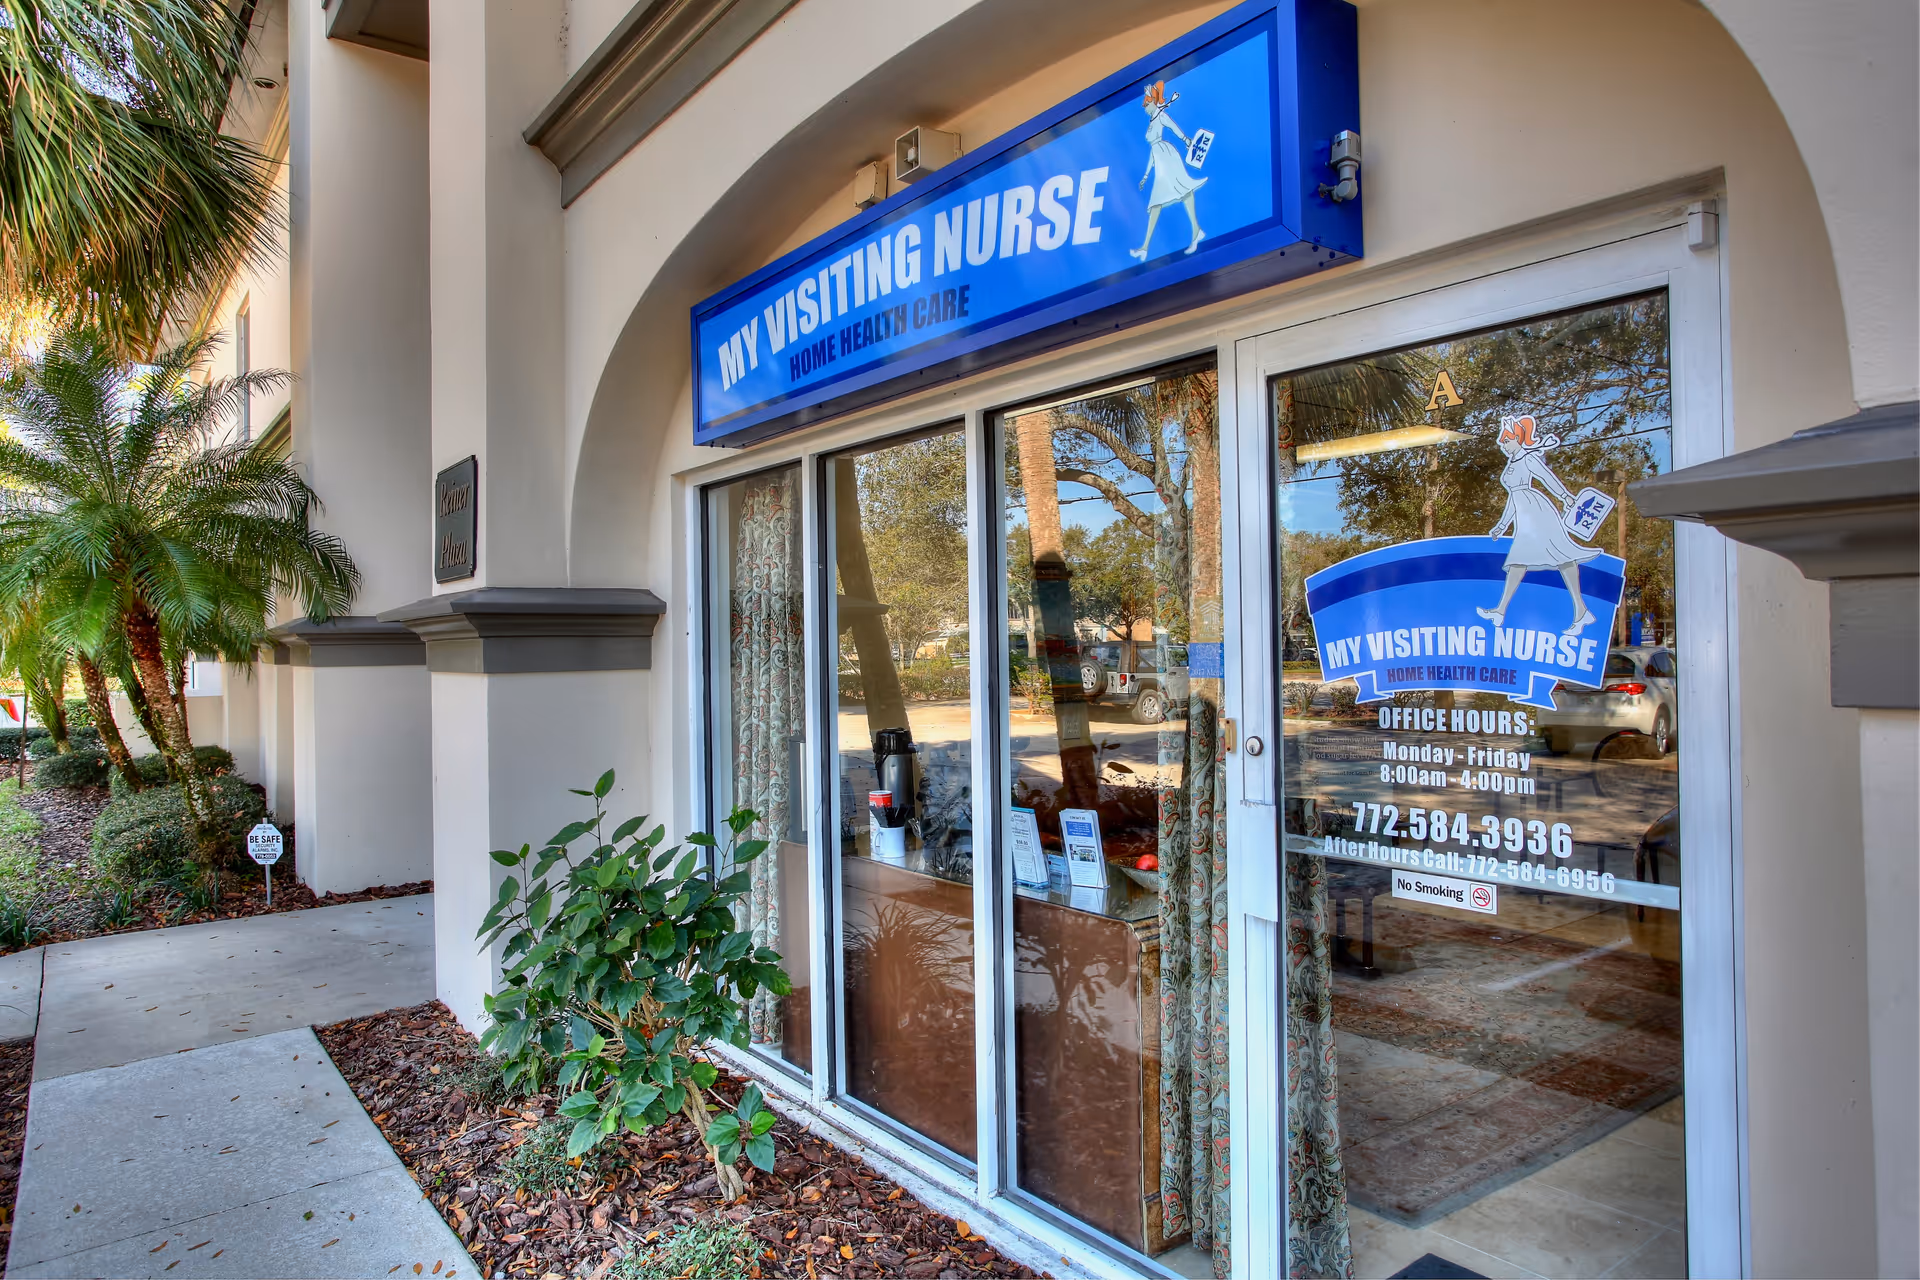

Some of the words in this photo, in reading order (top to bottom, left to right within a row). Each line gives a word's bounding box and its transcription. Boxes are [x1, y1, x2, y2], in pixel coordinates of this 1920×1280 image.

[718, 316, 758, 392] MY
[764, 224, 921, 355] VISITING
[934, 166, 1109, 277] NURSE
[789, 334, 836, 382] HOME
[840, 303, 907, 357] HEALTH
[912, 284, 970, 330] CARE
[1424, 370, 1465, 411] A
[440, 531, 468, 569] Plaza
[1325, 635, 1361, 669] MY
[1366, 625, 1486, 661] VISITING
[1493, 626, 1598, 672] NURSE
[1387, 666, 1424, 683] HOME
[1427, 665, 1475, 681] HEALTH
[1479, 667, 1517, 685] CARE
[1378, 706, 1447, 732] OFFICE
[1451, 709, 1535, 736] HOURS:
[1383, 741, 1454, 766] Monday
[1467, 746, 1531, 771] Friday
[1380, 764, 1447, 787] 8:00am
[1460, 769, 1535, 795] 4:00pm
[250, 835, 260, 843] BE
[261, 835, 281, 843] SAFE
[1352, 801, 1574, 859] 772.584.3936
[1324, 835, 1366, 857] After
[1368, 841, 1420, 866] Hours
[1423, 848, 1464, 872] Call:
[1466, 854, 1615, 894] 772-584-6956
[1397, 878, 1412, 890] No
[1415, 881, 1464, 902] Smoking
